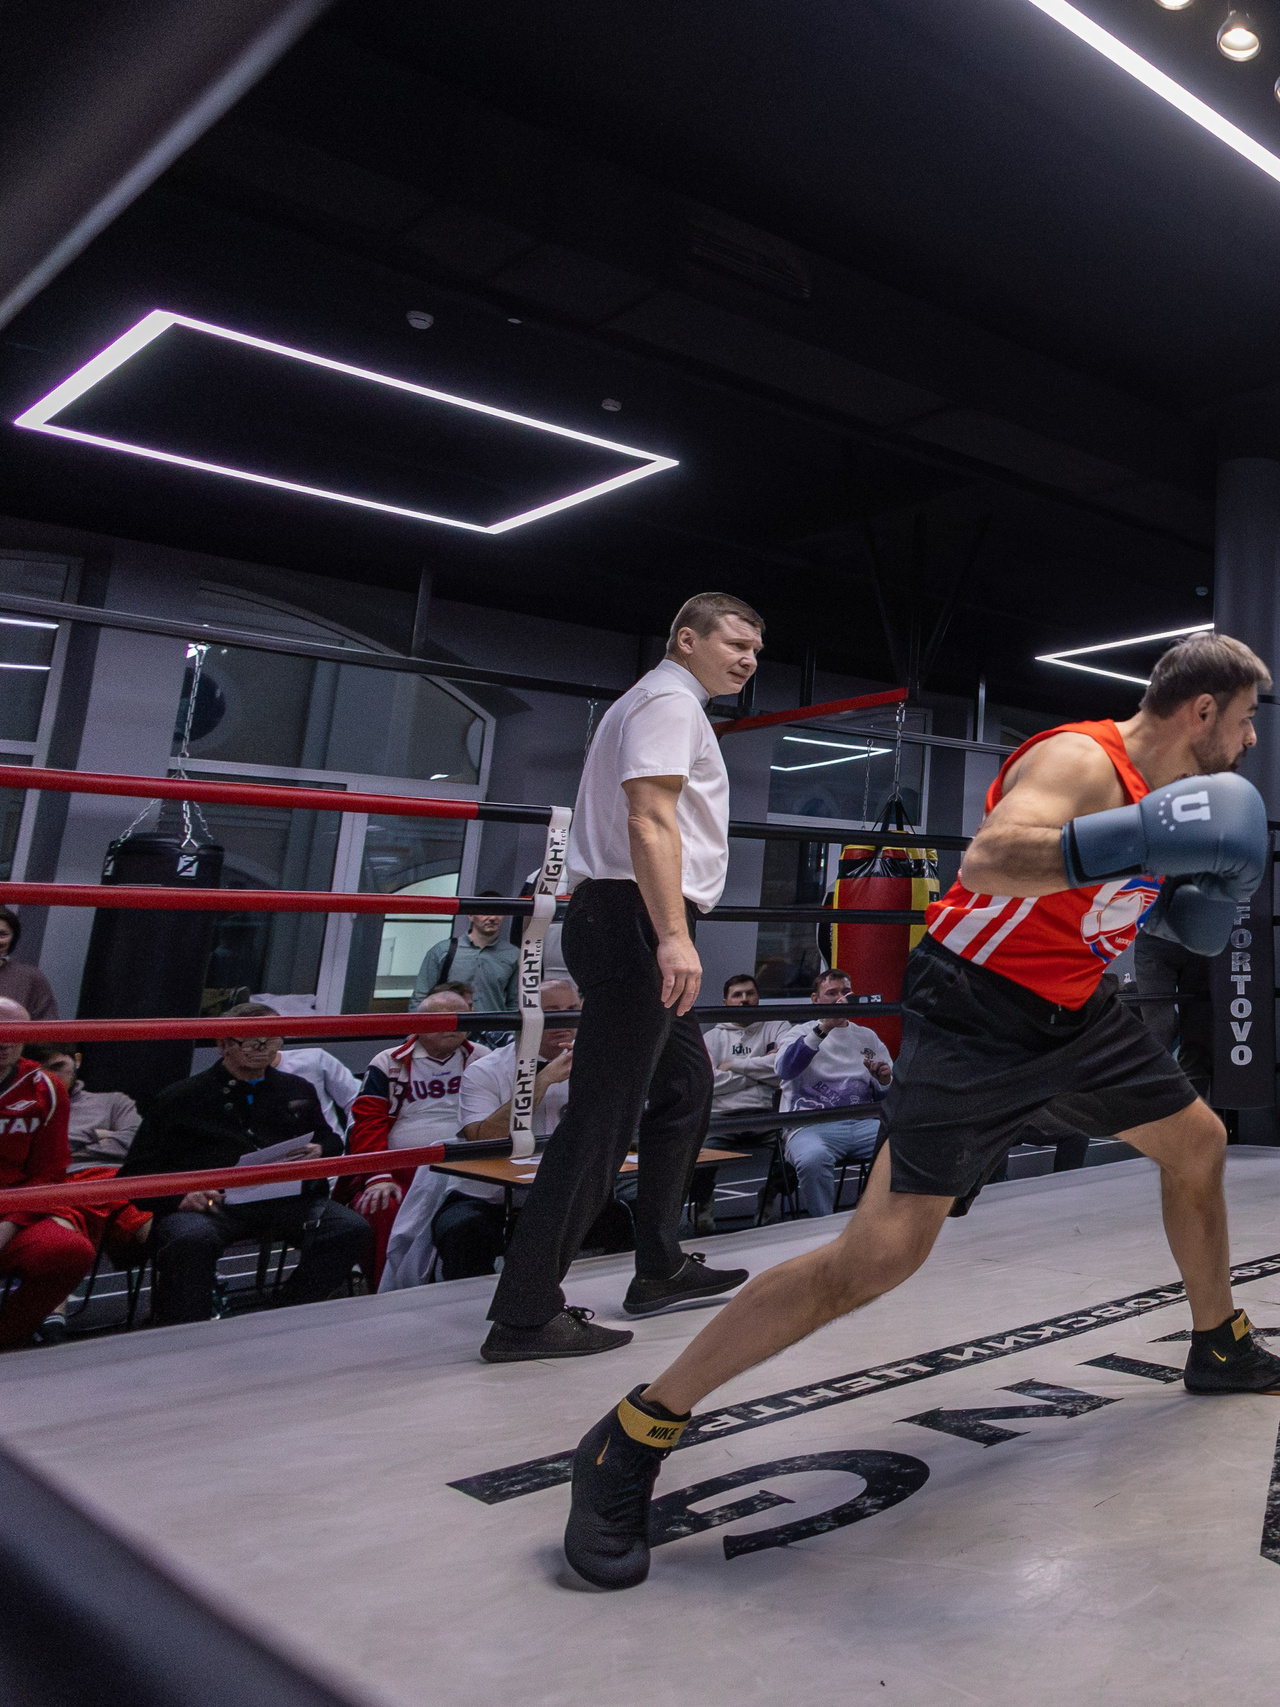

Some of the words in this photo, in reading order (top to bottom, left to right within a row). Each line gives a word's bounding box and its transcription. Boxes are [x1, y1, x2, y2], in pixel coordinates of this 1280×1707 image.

[538, 837, 565, 895] FIGHT
[522, 949, 539, 1009] FIGHT
[1230, 896, 1252, 1066] FORTOVO
[513, 1070, 535, 1132] FIGHT
[698, 1362, 936, 1432] ЦЕНТР
[646, 1426, 680, 1440] NIKE
